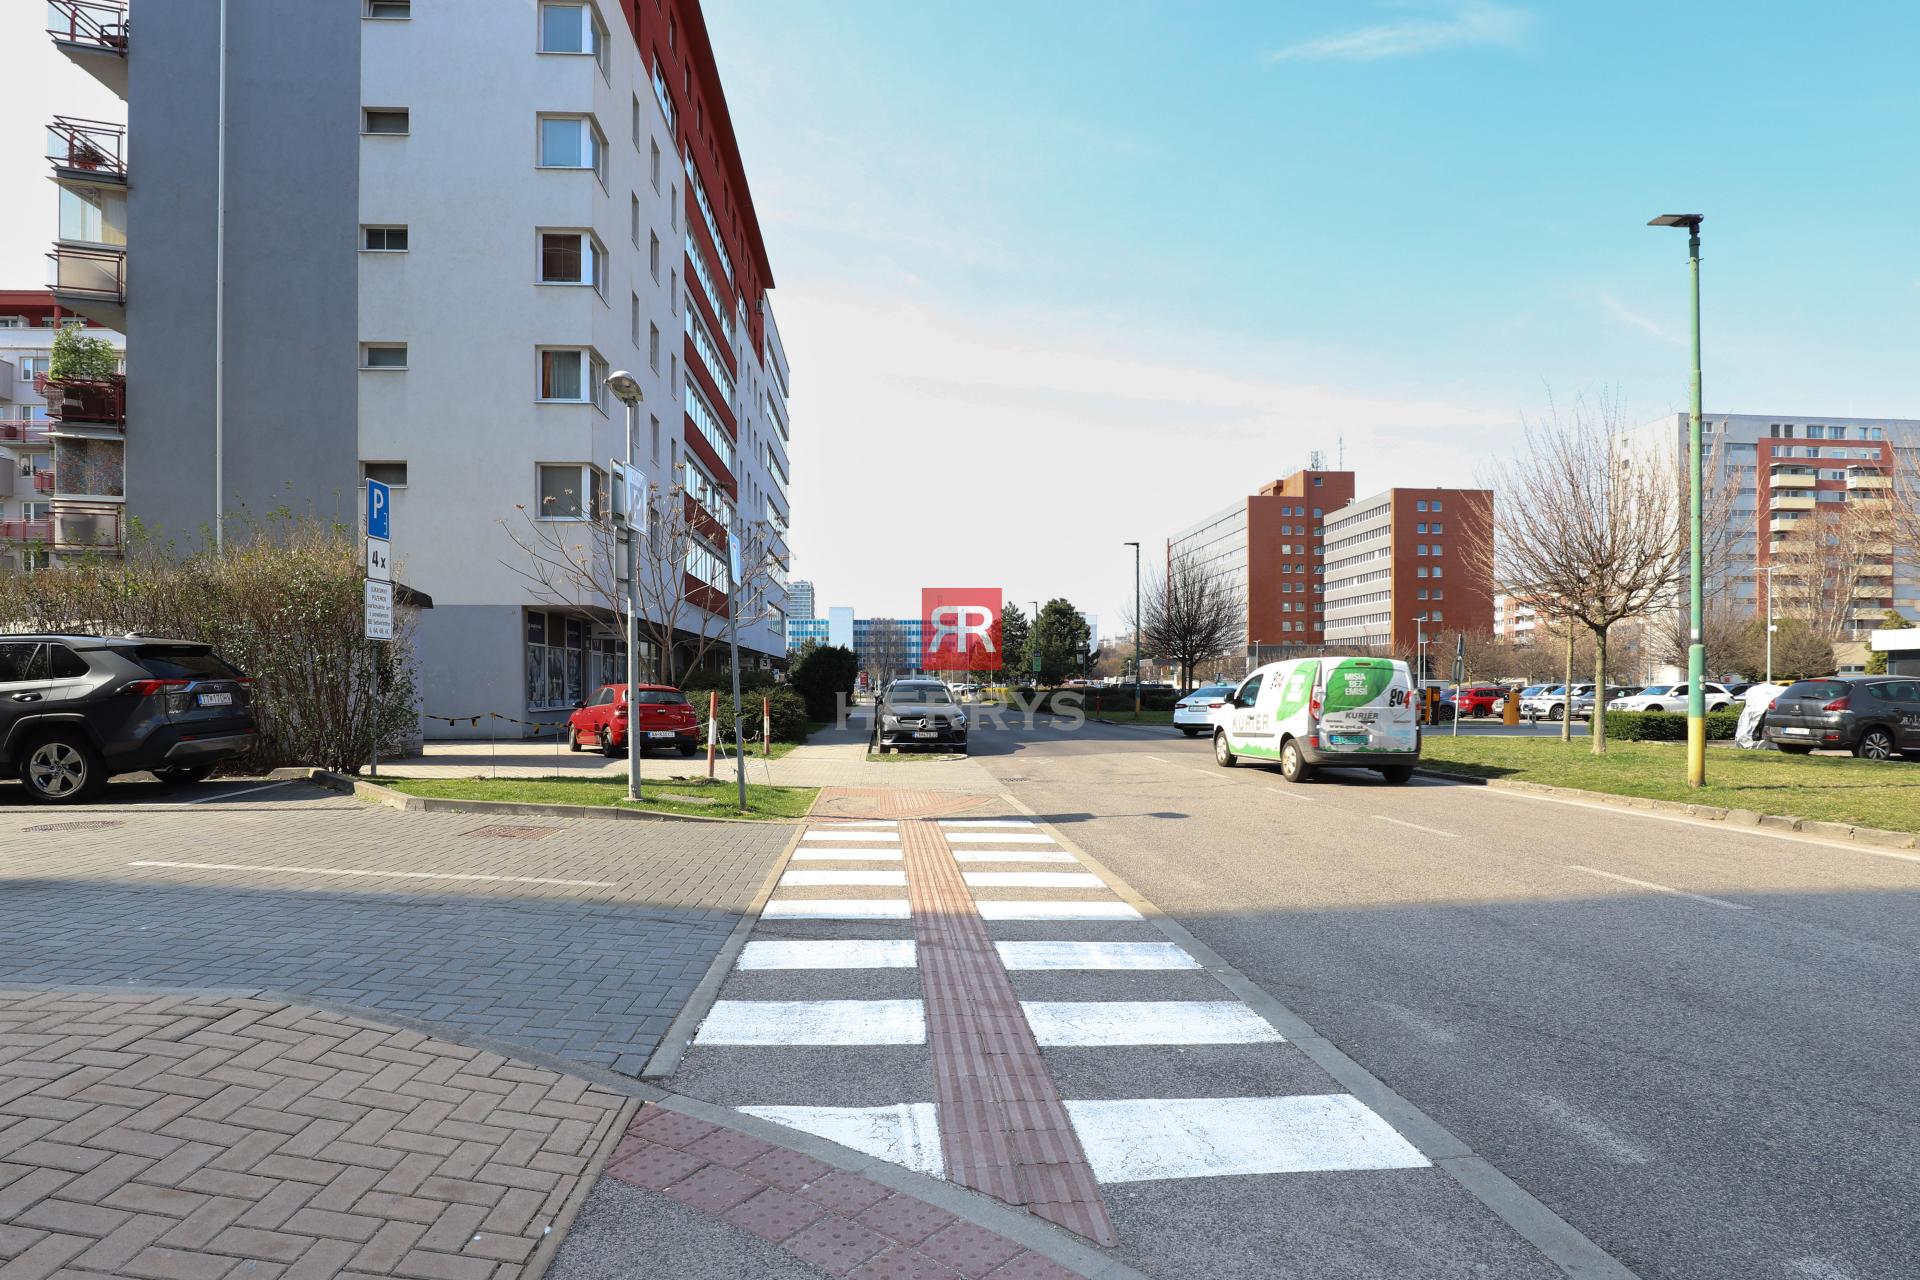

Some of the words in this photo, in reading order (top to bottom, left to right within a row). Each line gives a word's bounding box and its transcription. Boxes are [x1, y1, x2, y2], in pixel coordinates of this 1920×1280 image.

[373, 488, 384, 519] P
[1349, 680, 1363, 688] BEZ
[1389, 688, 1412, 709] go4
[1232, 713, 1270, 731] KURIER
